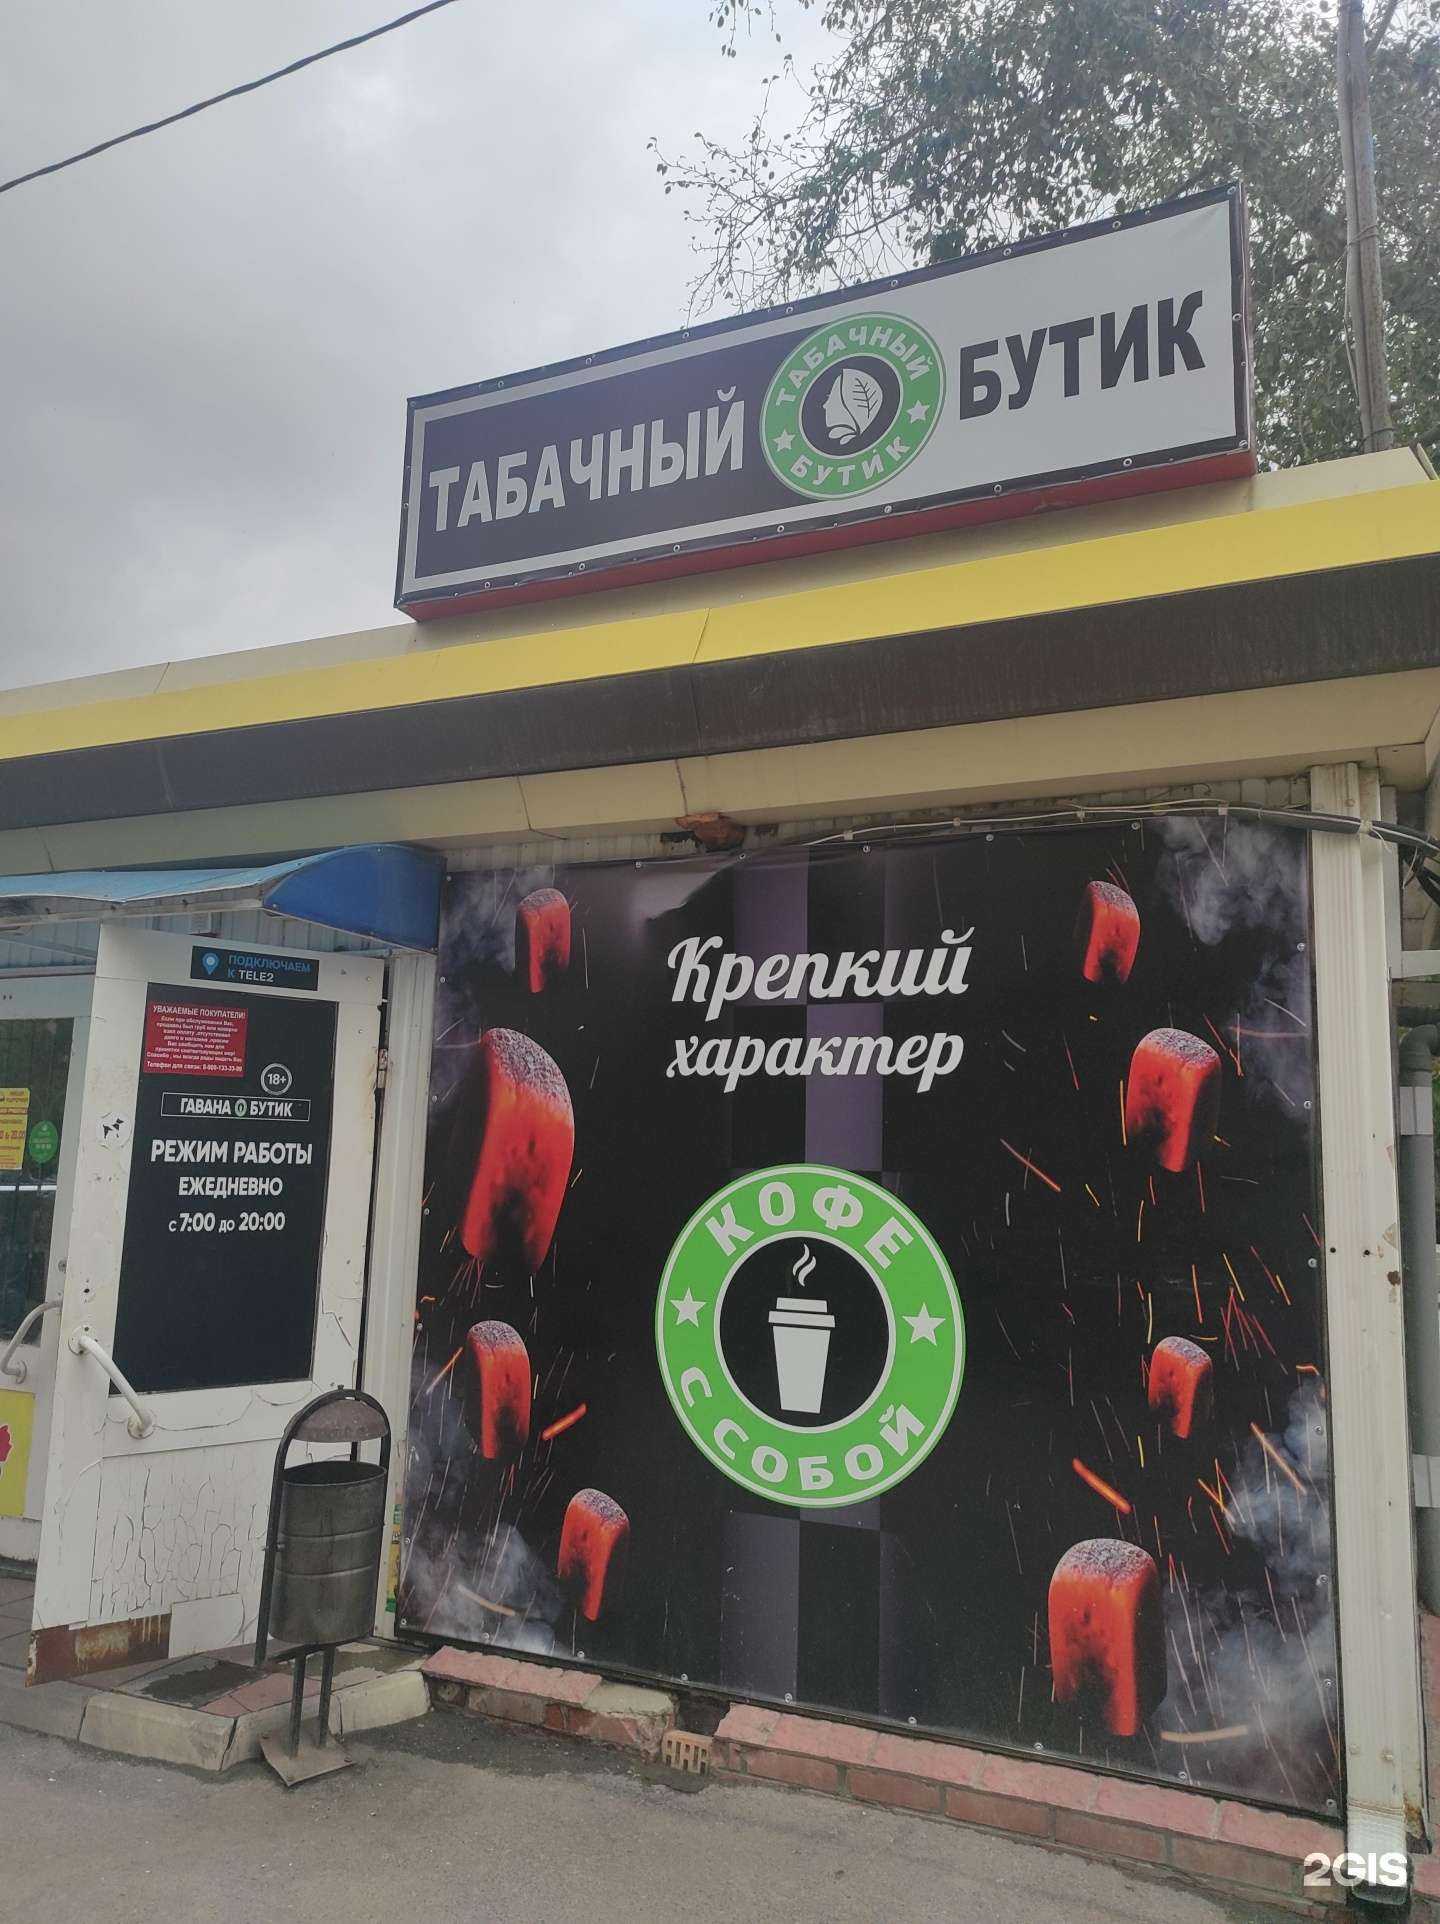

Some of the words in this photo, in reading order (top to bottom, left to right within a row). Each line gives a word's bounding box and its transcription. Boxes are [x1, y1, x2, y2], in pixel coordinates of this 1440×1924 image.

[776, 325, 933, 405] ТАБАЧНЫЙ
[429, 386, 745, 531] ТАБАЧНЫЙ
[959, 291, 1205, 420] БУТИК
[791, 439, 912, 484] БУТИК
[229, 955, 310, 972] ПОДКЛЮЧАЕМ
[668, 927, 975, 1021] Крепкий
[238, 970, 274, 982] TELE2
[153, 1005, 199, 1016] УВАЖАЕМЫЕ
[200, 1009, 245, 1019] ПОКУПАТЕЛИ!
[666, 1033, 963, 1092] характер
[268, 1073, 286, 1086] 18+
[180, 1098, 231, 1115] ГАВАНА
[250, 1101, 292, 1117] БУТИК
[150, 1140, 228, 1163] РЕЖИМ
[234, 1142, 312, 1164] РАБОТЫ
[179, 1177, 283, 1198] ЕЖЕДНЕВНО
[179, 1212, 215, 1232] 7:00
[239, 1212, 285, 1231] 20:00
[705, 1182, 914, 1269] КОФЕ
